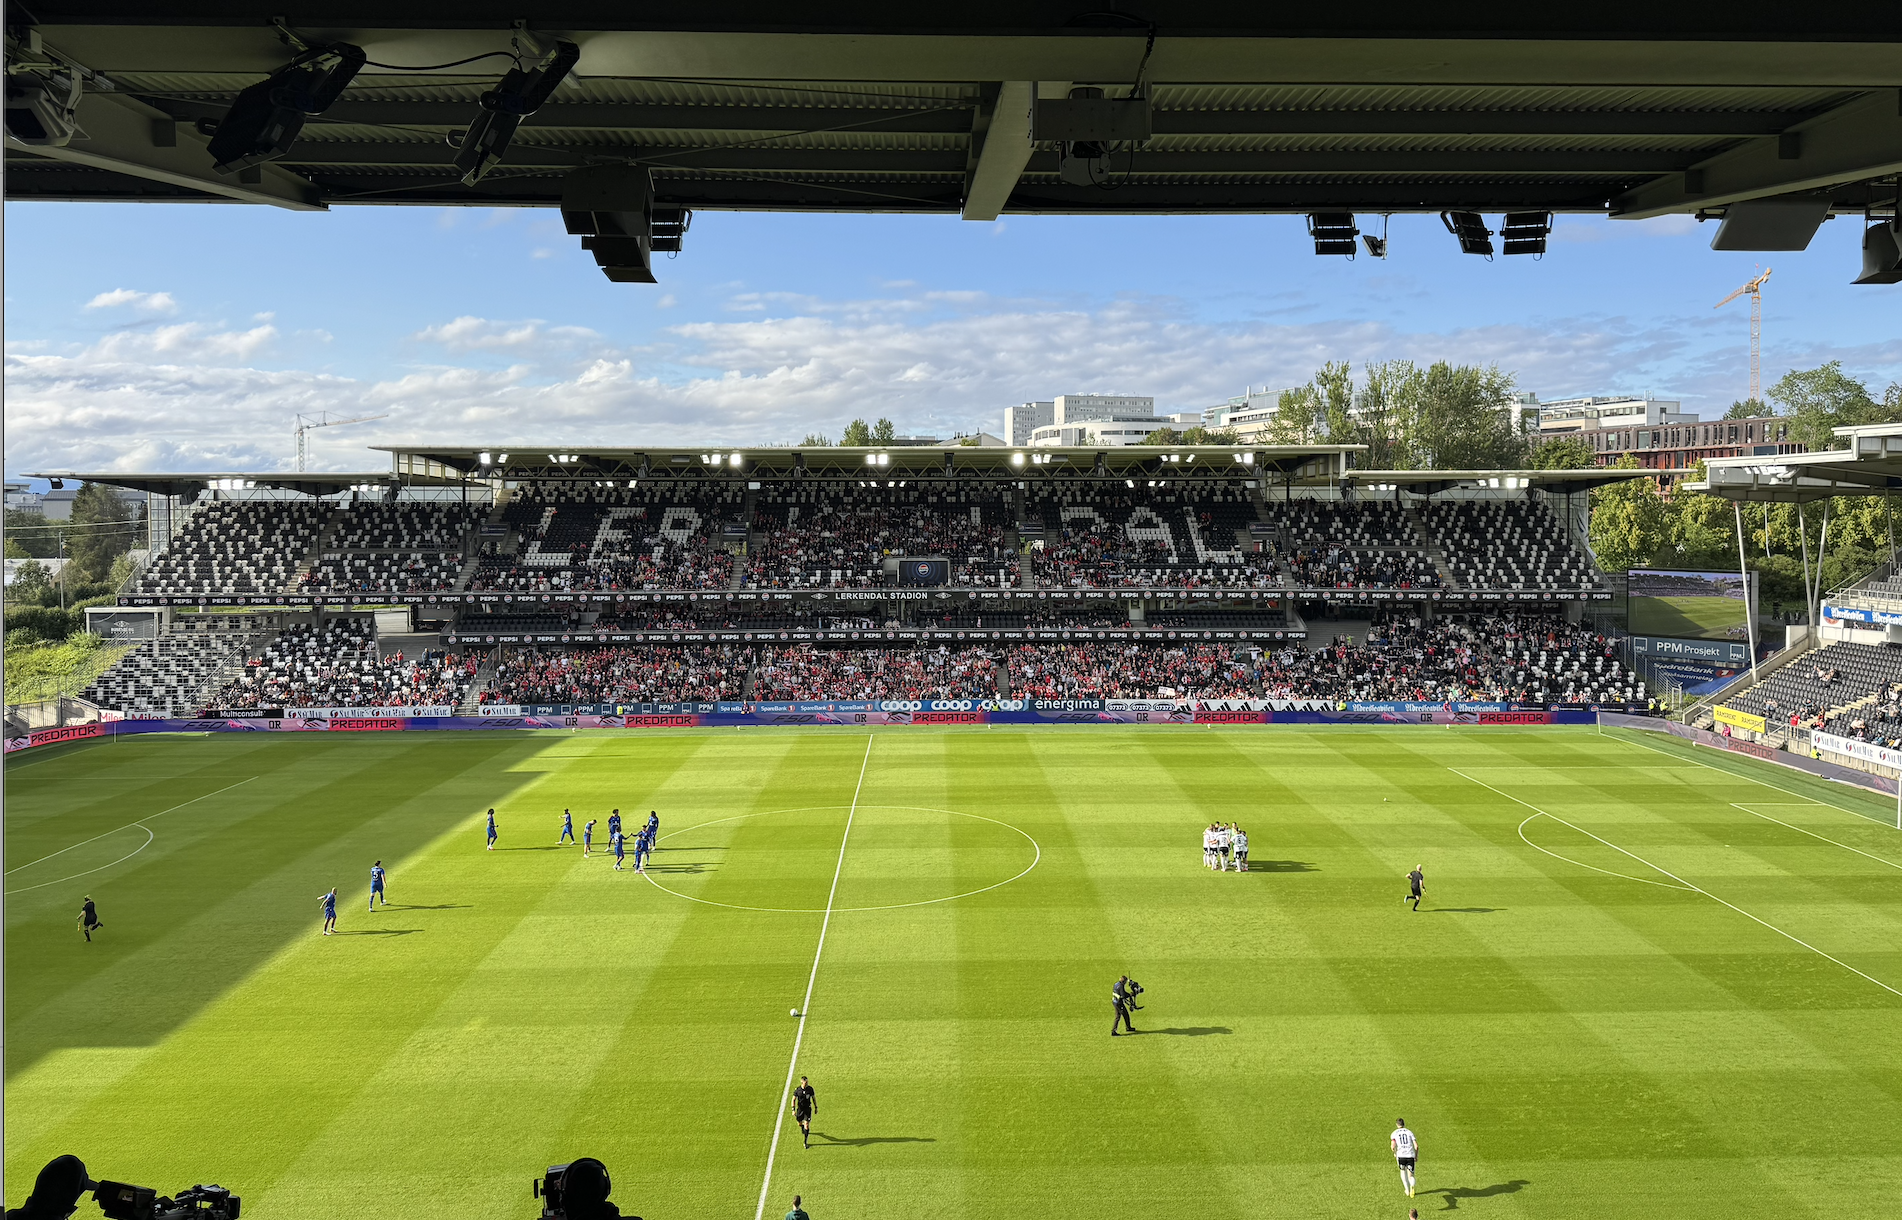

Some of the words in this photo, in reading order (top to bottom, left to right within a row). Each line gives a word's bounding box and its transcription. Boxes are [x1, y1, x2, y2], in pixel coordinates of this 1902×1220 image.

[1656, 642, 1682, 652] PPM
[1684, 646, 1720, 656] Prosjekt
[880, 700, 922, 711] coop
[932, 700, 972, 711] coop
[1034, 700, 1099, 711] energima
[627, 716, 691, 725] PREDATOR
[855, 714, 867, 722] OR
[914, 714, 976, 722] PREDATOR
[1137, 713, 1149, 721] OR
[1196, 713, 1259, 721] PREDATOR
[1420, 714, 1432, 722] OR
[1481, 714, 1544, 722] PREDATOR
[269, 721, 281, 729] OR
[332, 720, 397, 728] PREDATOR
[565, 718, 578, 726] OR
[32, 726, 97, 744] PREDATOR
[1728, 739, 1773, 759] PREDATOR
[1399, 1134, 1408, 1145] 10
